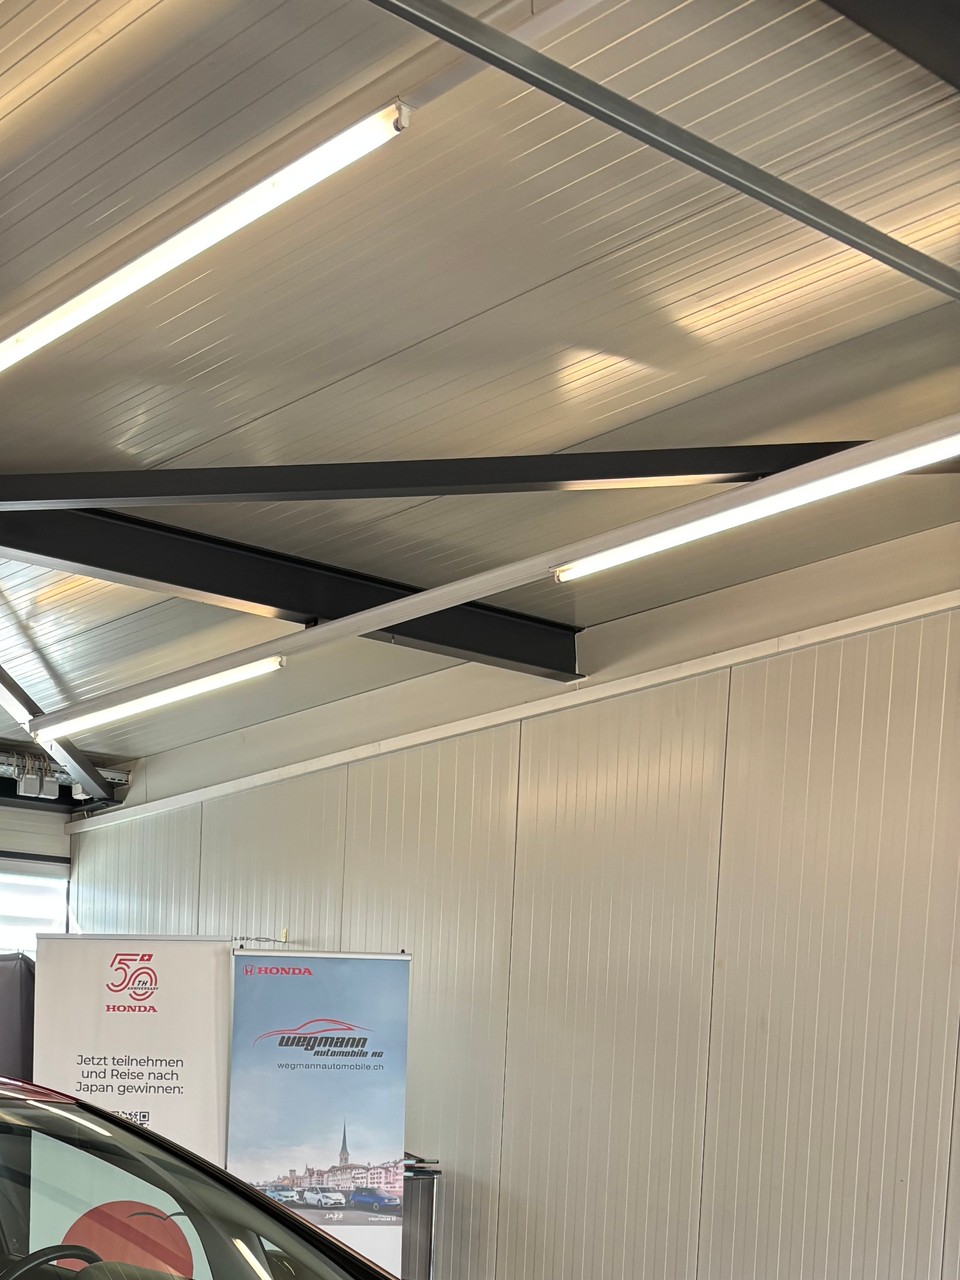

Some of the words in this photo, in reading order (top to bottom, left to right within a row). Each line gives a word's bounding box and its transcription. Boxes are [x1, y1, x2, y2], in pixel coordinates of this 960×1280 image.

[257, 966, 313, 976] HONDA
[105, 1005, 158, 1013] HONDA
[278, 1035, 368, 1051] wegmann
[76, 1054, 108, 1066] Jetzt
[111, 1055, 184, 1068] teilnehmen
[277, 1062, 384, 1071] wegmannautomobile.ch
[81, 1068, 107, 1079] und
[110, 1068, 144, 1080] Reise
[148, 1070, 179, 1081] nach
[75, 1081, 114, 1094] Japan
[117, 1082, 184, 1096] gewinnen:
